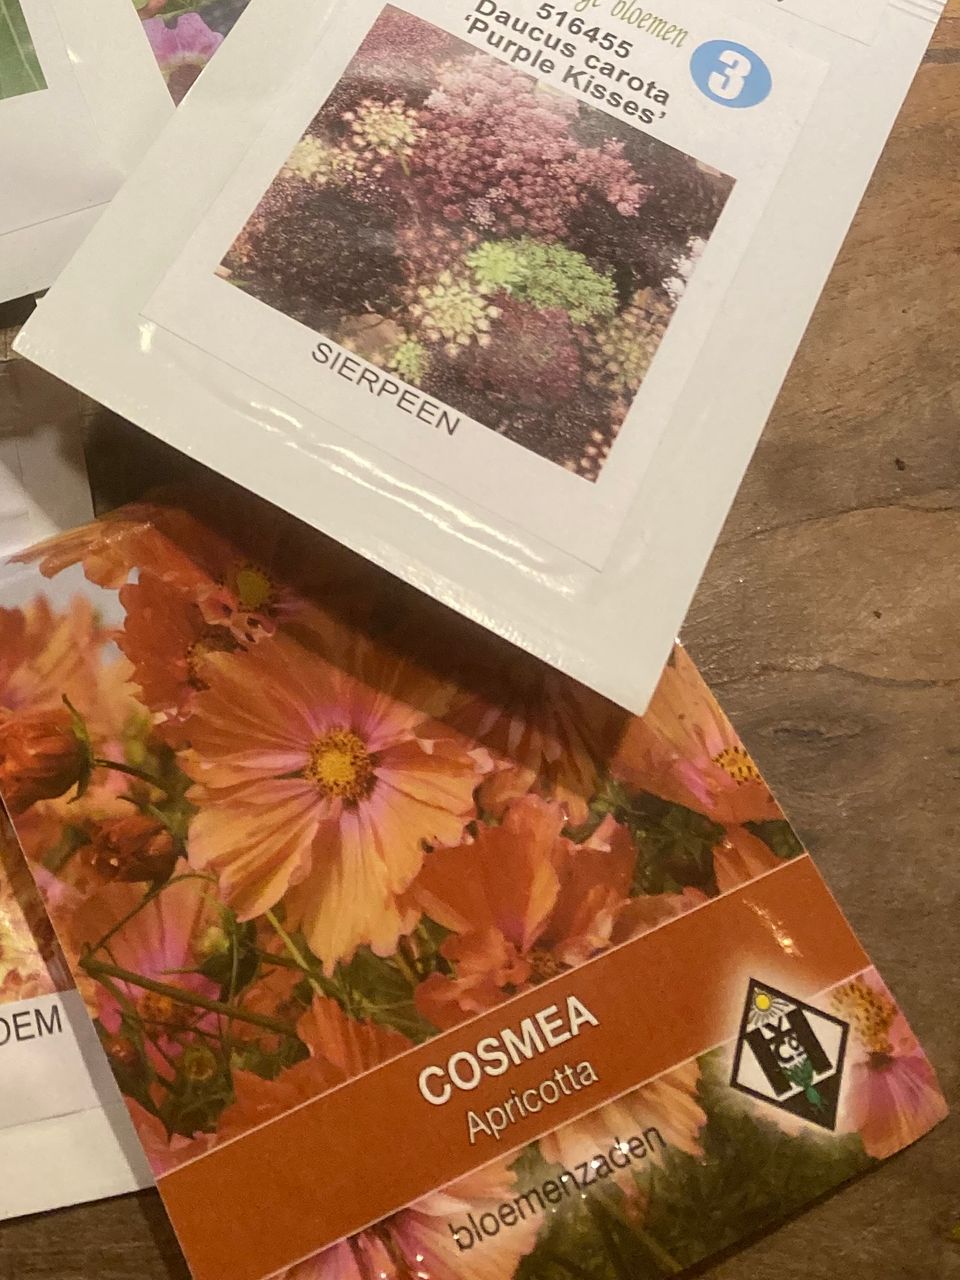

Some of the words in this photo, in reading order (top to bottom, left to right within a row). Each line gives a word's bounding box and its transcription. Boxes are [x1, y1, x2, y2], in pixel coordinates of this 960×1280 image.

[536, 1, 634, 59] 516455
[584, 52, 671, 106] carota
[708, 50, 751, 100] 3
[311, 342, 461, 436] SIERPEEN
[417, 995, 600, 1107] COSMEA
[466, 1058, 600, 1145] Apricotta
[449, 1125, 668, 1253] bloemenzaden
